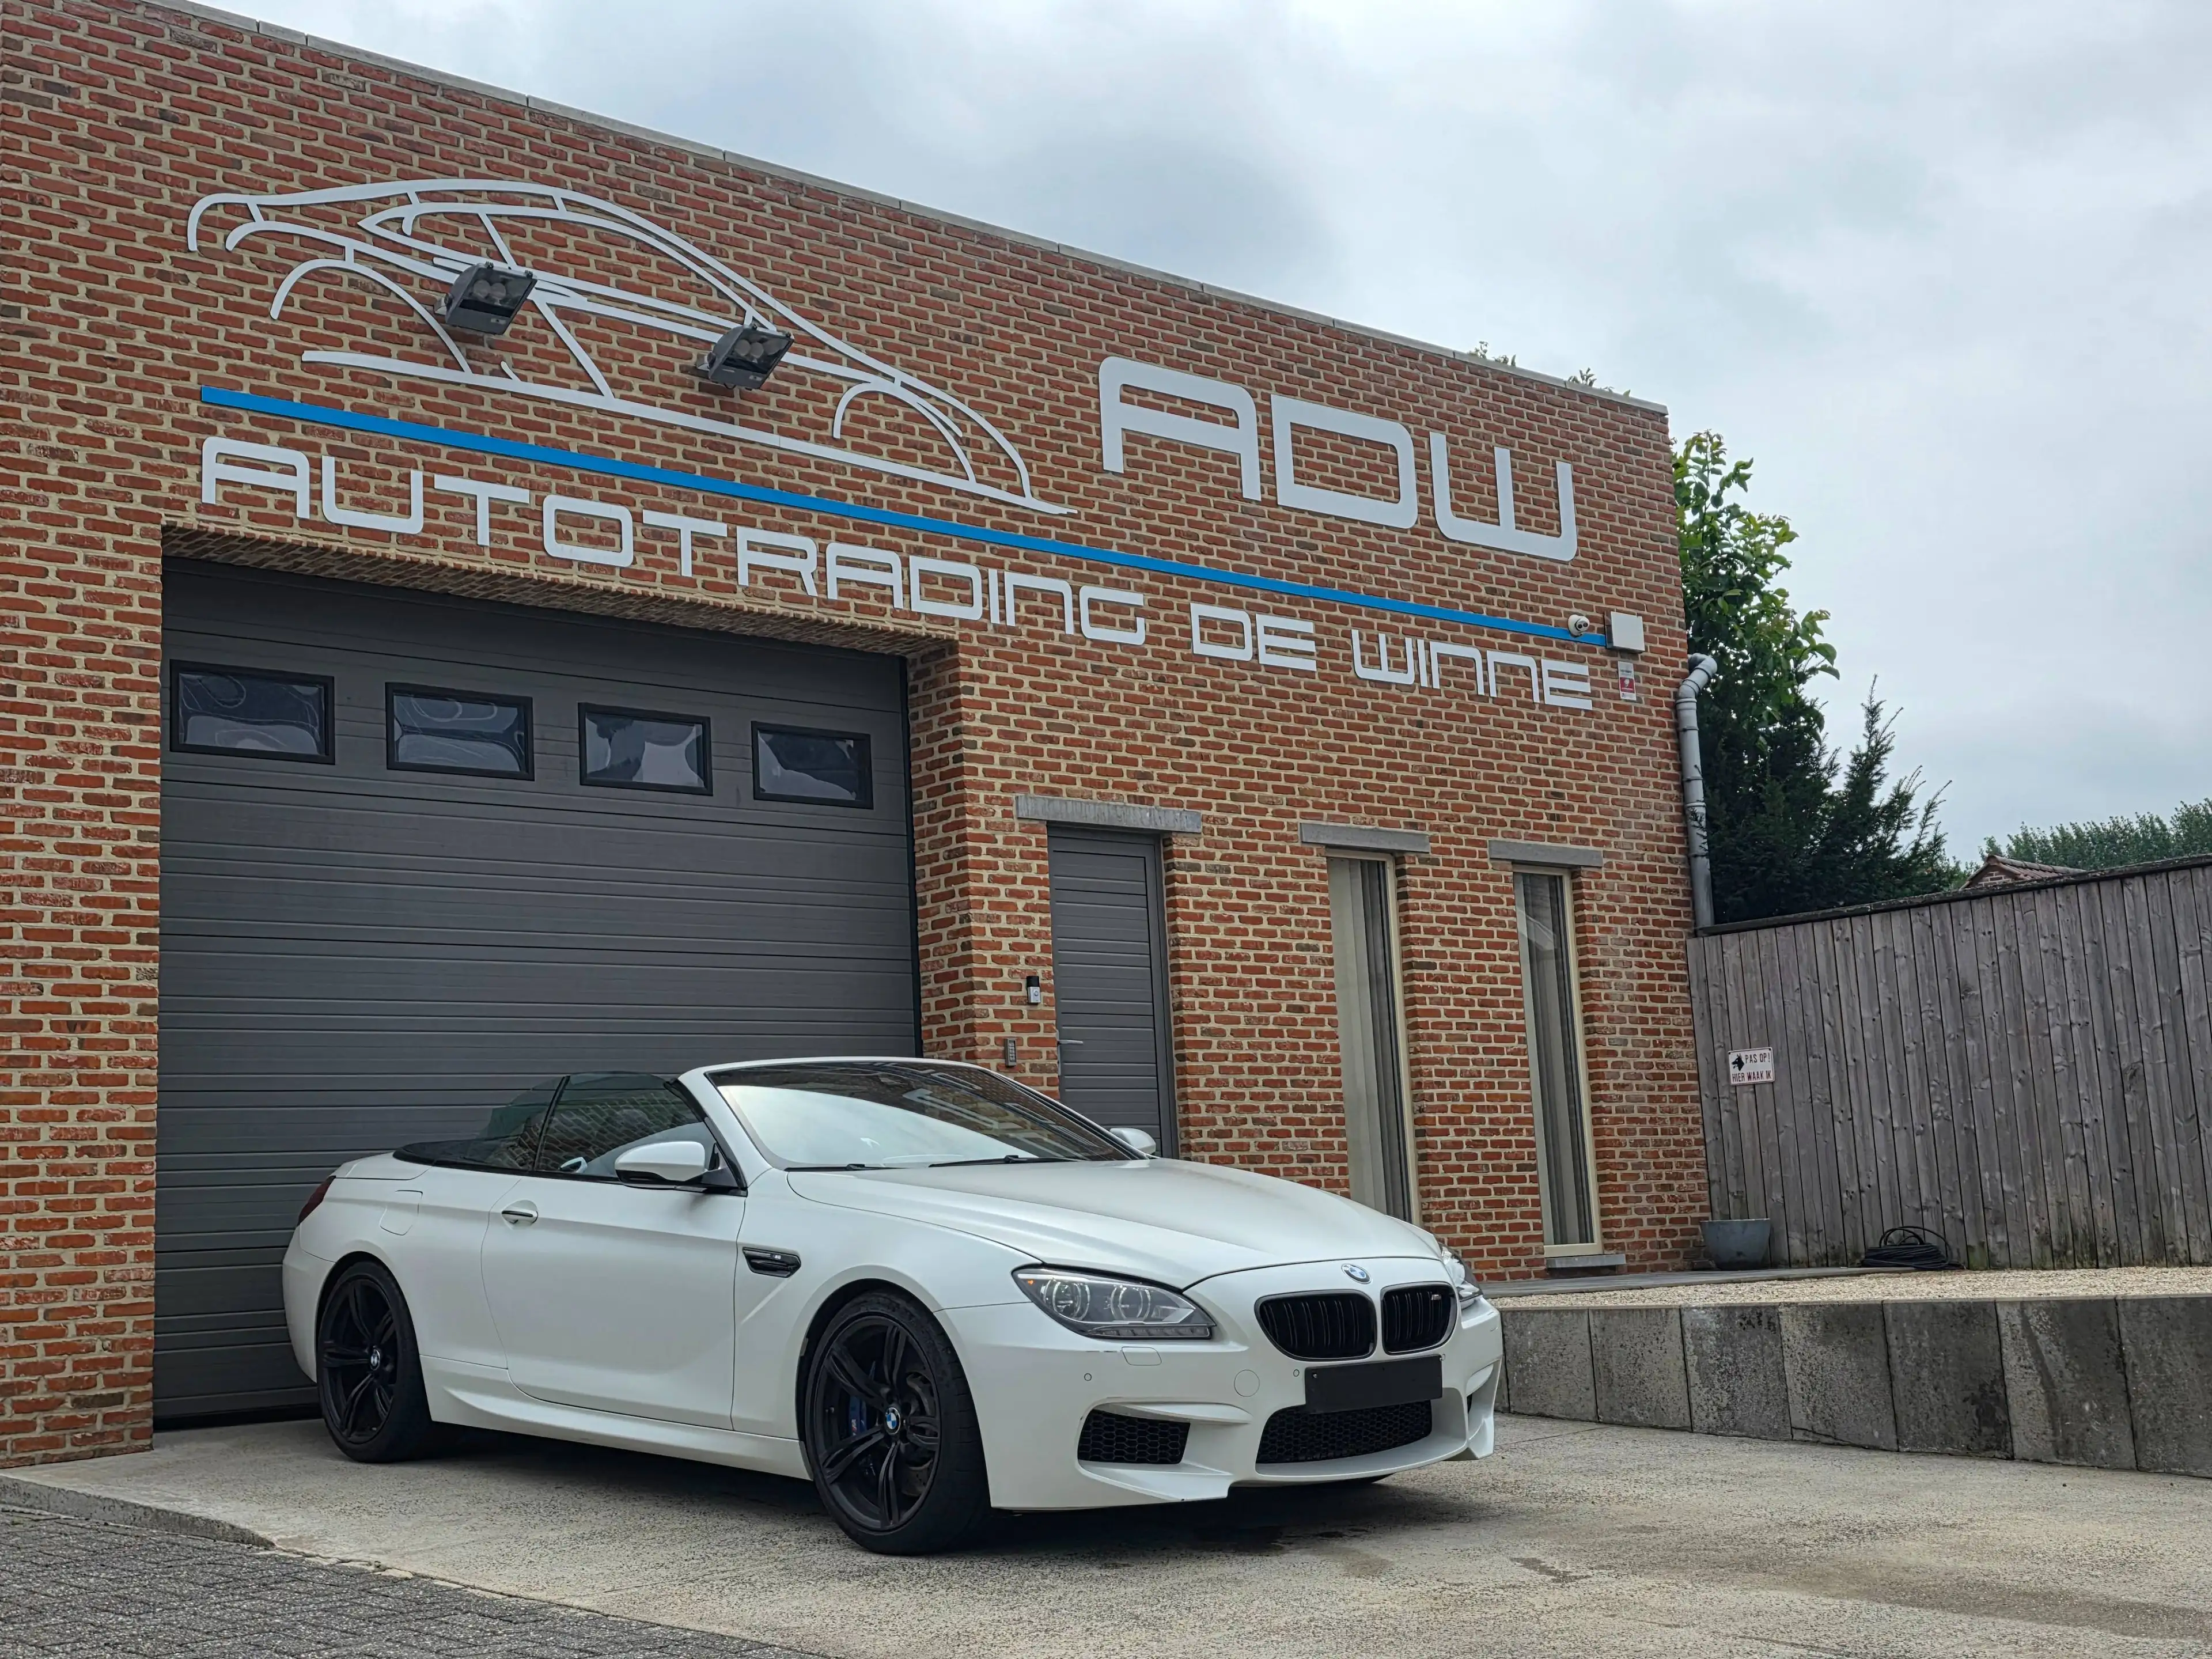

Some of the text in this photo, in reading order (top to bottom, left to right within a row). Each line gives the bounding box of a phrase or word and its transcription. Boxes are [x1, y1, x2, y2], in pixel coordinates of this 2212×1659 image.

[1099, 356, 1577, 562] ADW
[202, 436, 1593, 710] AUTOTRADING DE WINNE
[1732, 1070, 1772, 1082] HIER WAAK IK
[1745, 1052, 1770, 1063] PAS OP!
